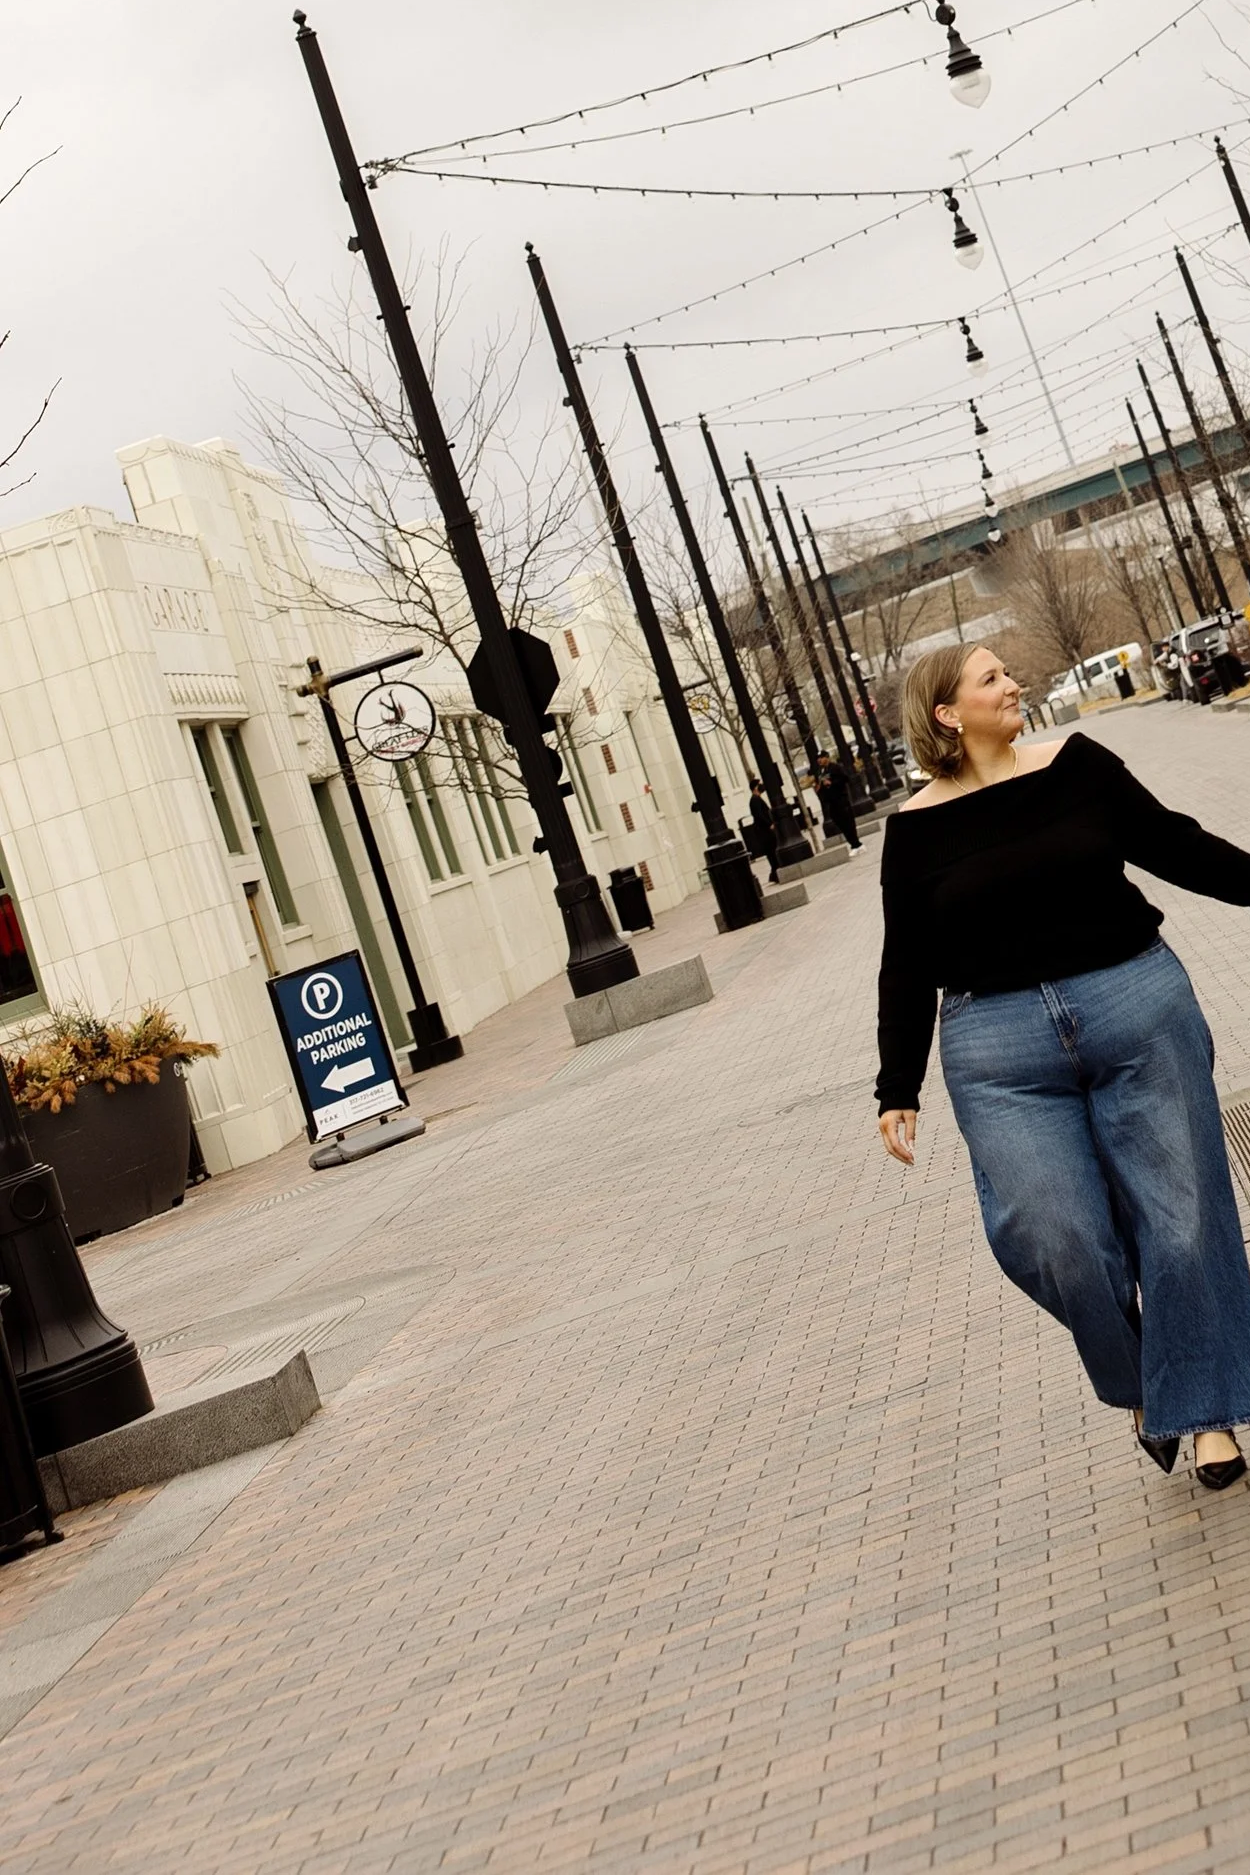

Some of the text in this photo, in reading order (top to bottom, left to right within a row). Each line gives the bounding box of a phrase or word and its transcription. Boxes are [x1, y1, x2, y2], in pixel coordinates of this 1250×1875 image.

[143, 585, 209, 632] GARAGE
[312, 981, 331, 1011] P
[296, 1012, 372, 1053] ADDITIONAL
[310, 1032, 366, 1065] PARKING
[319, 1113, 339, 1126] PEAK
